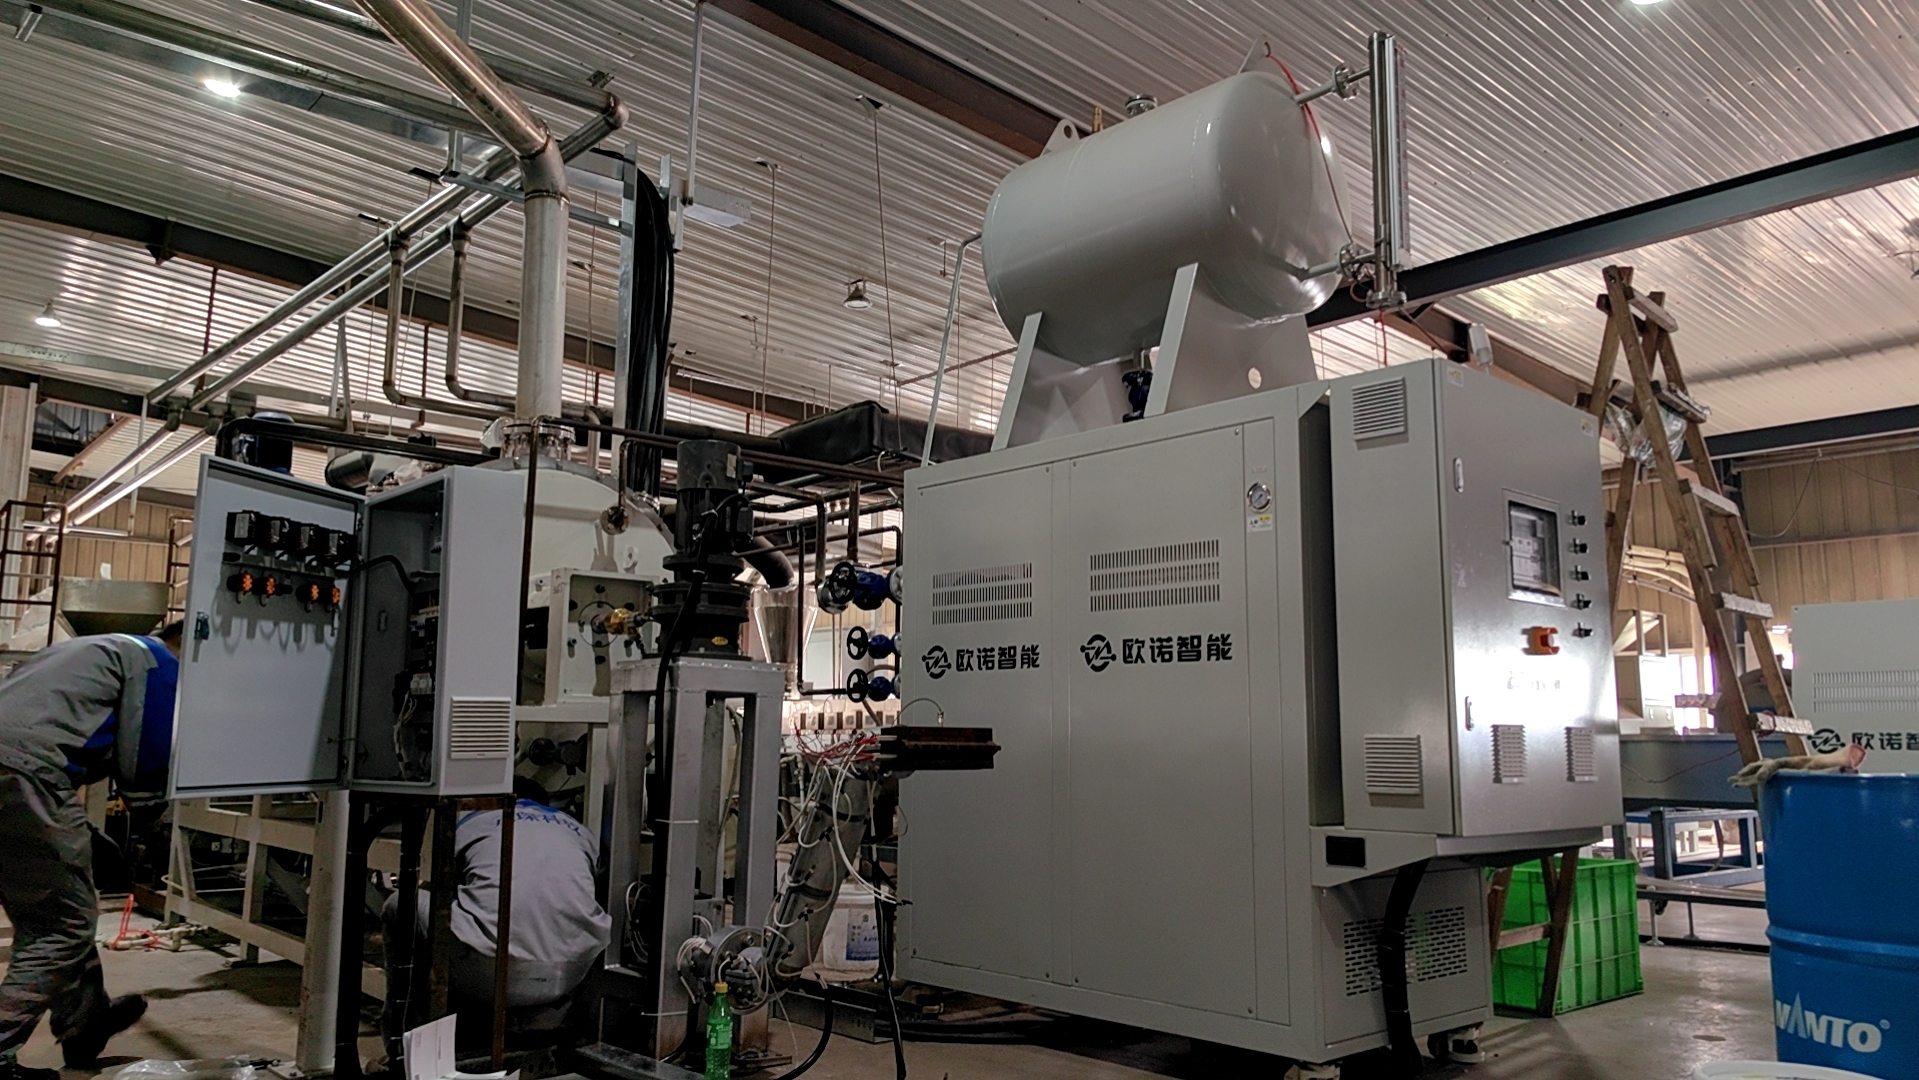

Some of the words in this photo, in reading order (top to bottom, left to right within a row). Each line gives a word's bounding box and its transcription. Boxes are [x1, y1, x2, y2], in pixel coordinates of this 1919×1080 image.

[955, 644, 1040, 673] 欧诺智能
[1122, 633, 1233, 665] 欧诺智能
